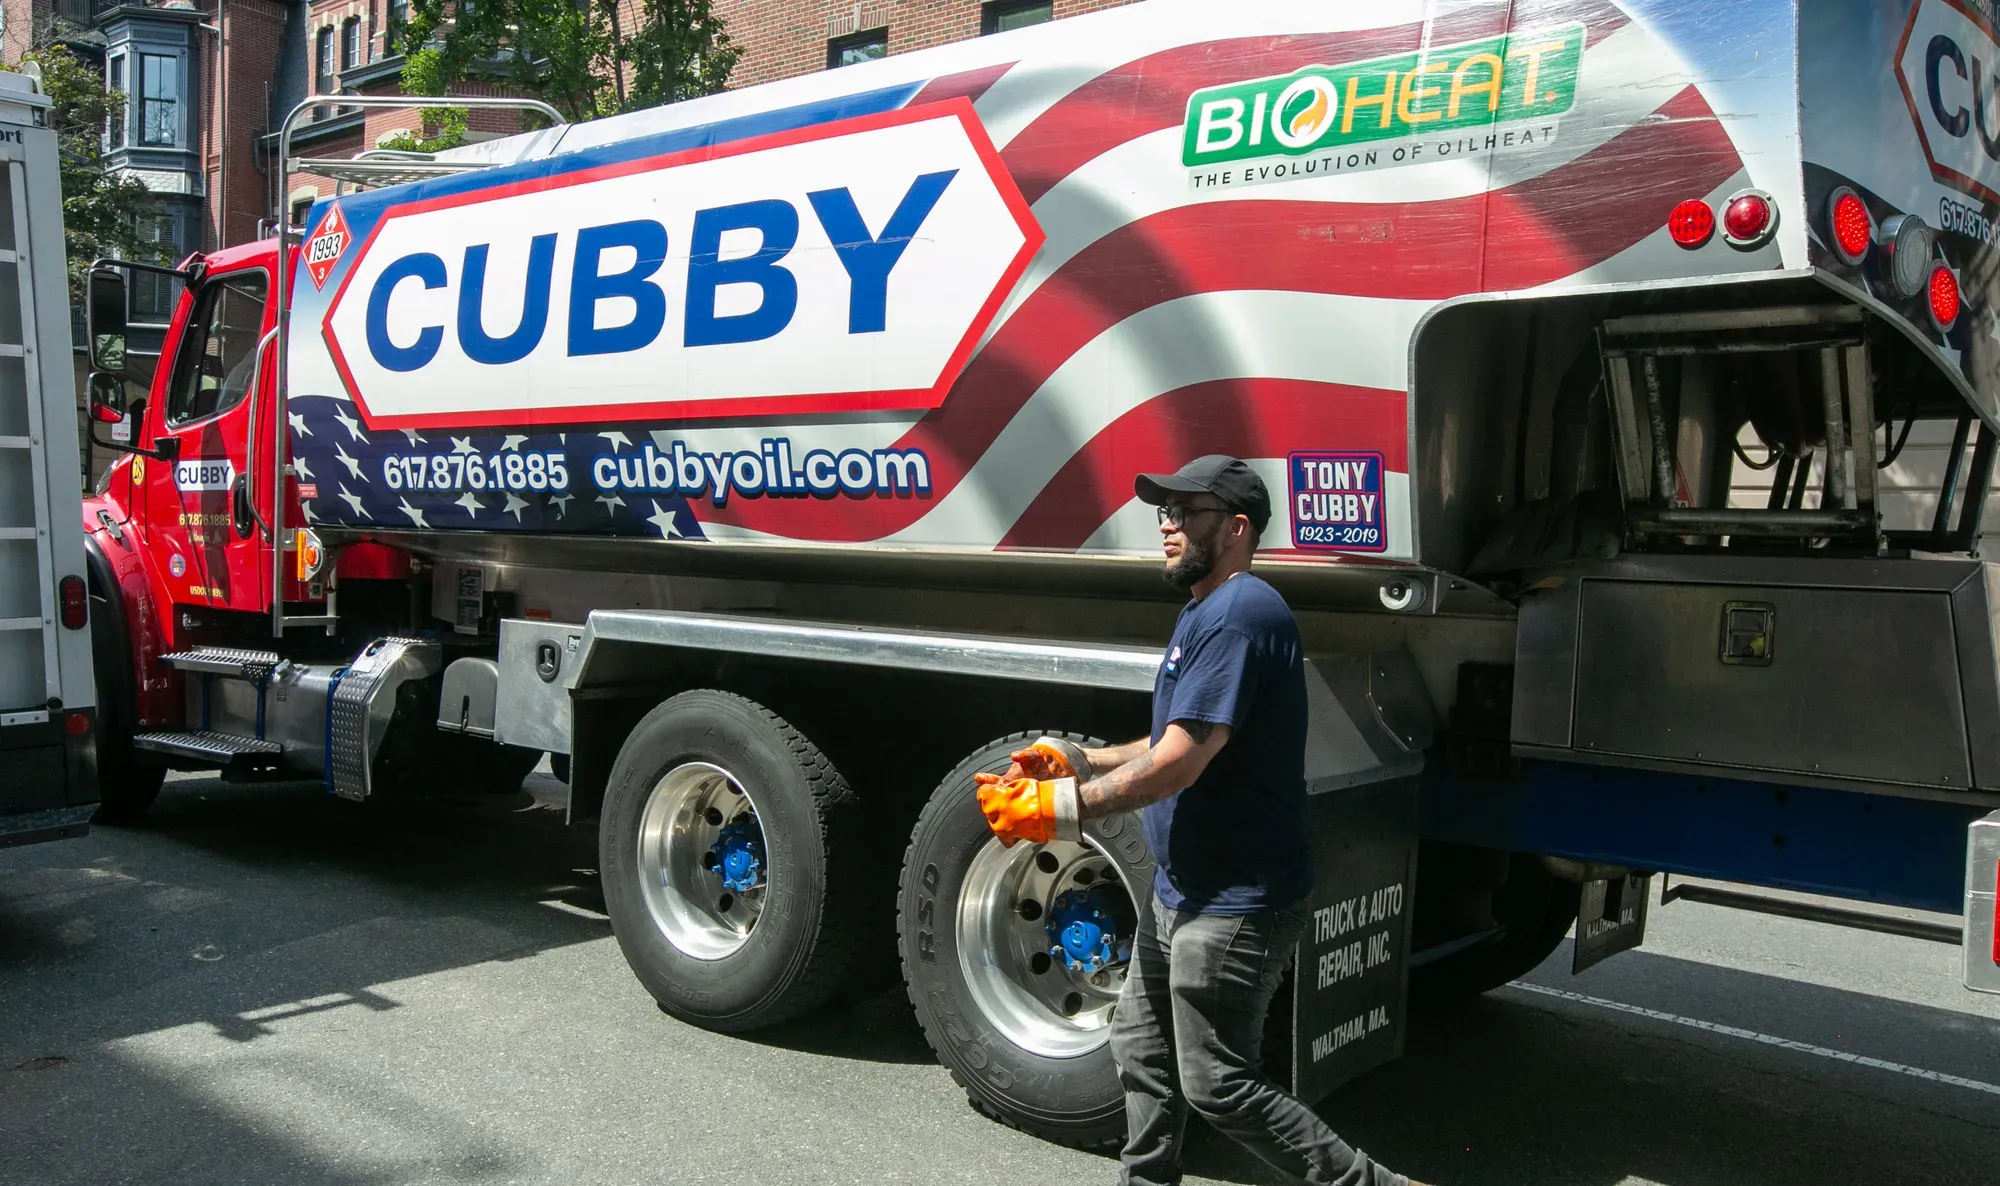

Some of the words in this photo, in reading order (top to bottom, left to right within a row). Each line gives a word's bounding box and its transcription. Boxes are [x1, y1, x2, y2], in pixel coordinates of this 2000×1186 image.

[1194, 172, 1231, 188] THE
[1244, 151, 1378, 183] EVOLUTION
[1393, 144, 1422, 161] OF
[1437, 126, 1554, 157] OILHEAT
[312, 234, 342, 262] 1993
[318, 267, 325, 280] 3
[365, 168, 960, 373] CUBBY
[177, 466, 231, 485] CUBBY
[382, 451, 569, 491] 617.876.1885
[592, 440, 930, 501] cubbyoil.com
[1303, 461, 1367, 490] TONY
[1297, 493, 1376, 523] CUBBY
[1299, 526, 1379, 543] 1923-2019
[917, 862, 941, 965] RSD
[1313, 898, 1357, 945] TRUCK
[1357, 895, 1367, 928] &
[1369, 883, 1403, 924] AUTO
[1317, 941, 1364, 991] REPAIR,
[1366, 930, 1391, 968] INC.
[1312, 1014, 1366, 1063] WALTHAM,
[1368, 1005, 1390, 1032] MA.
